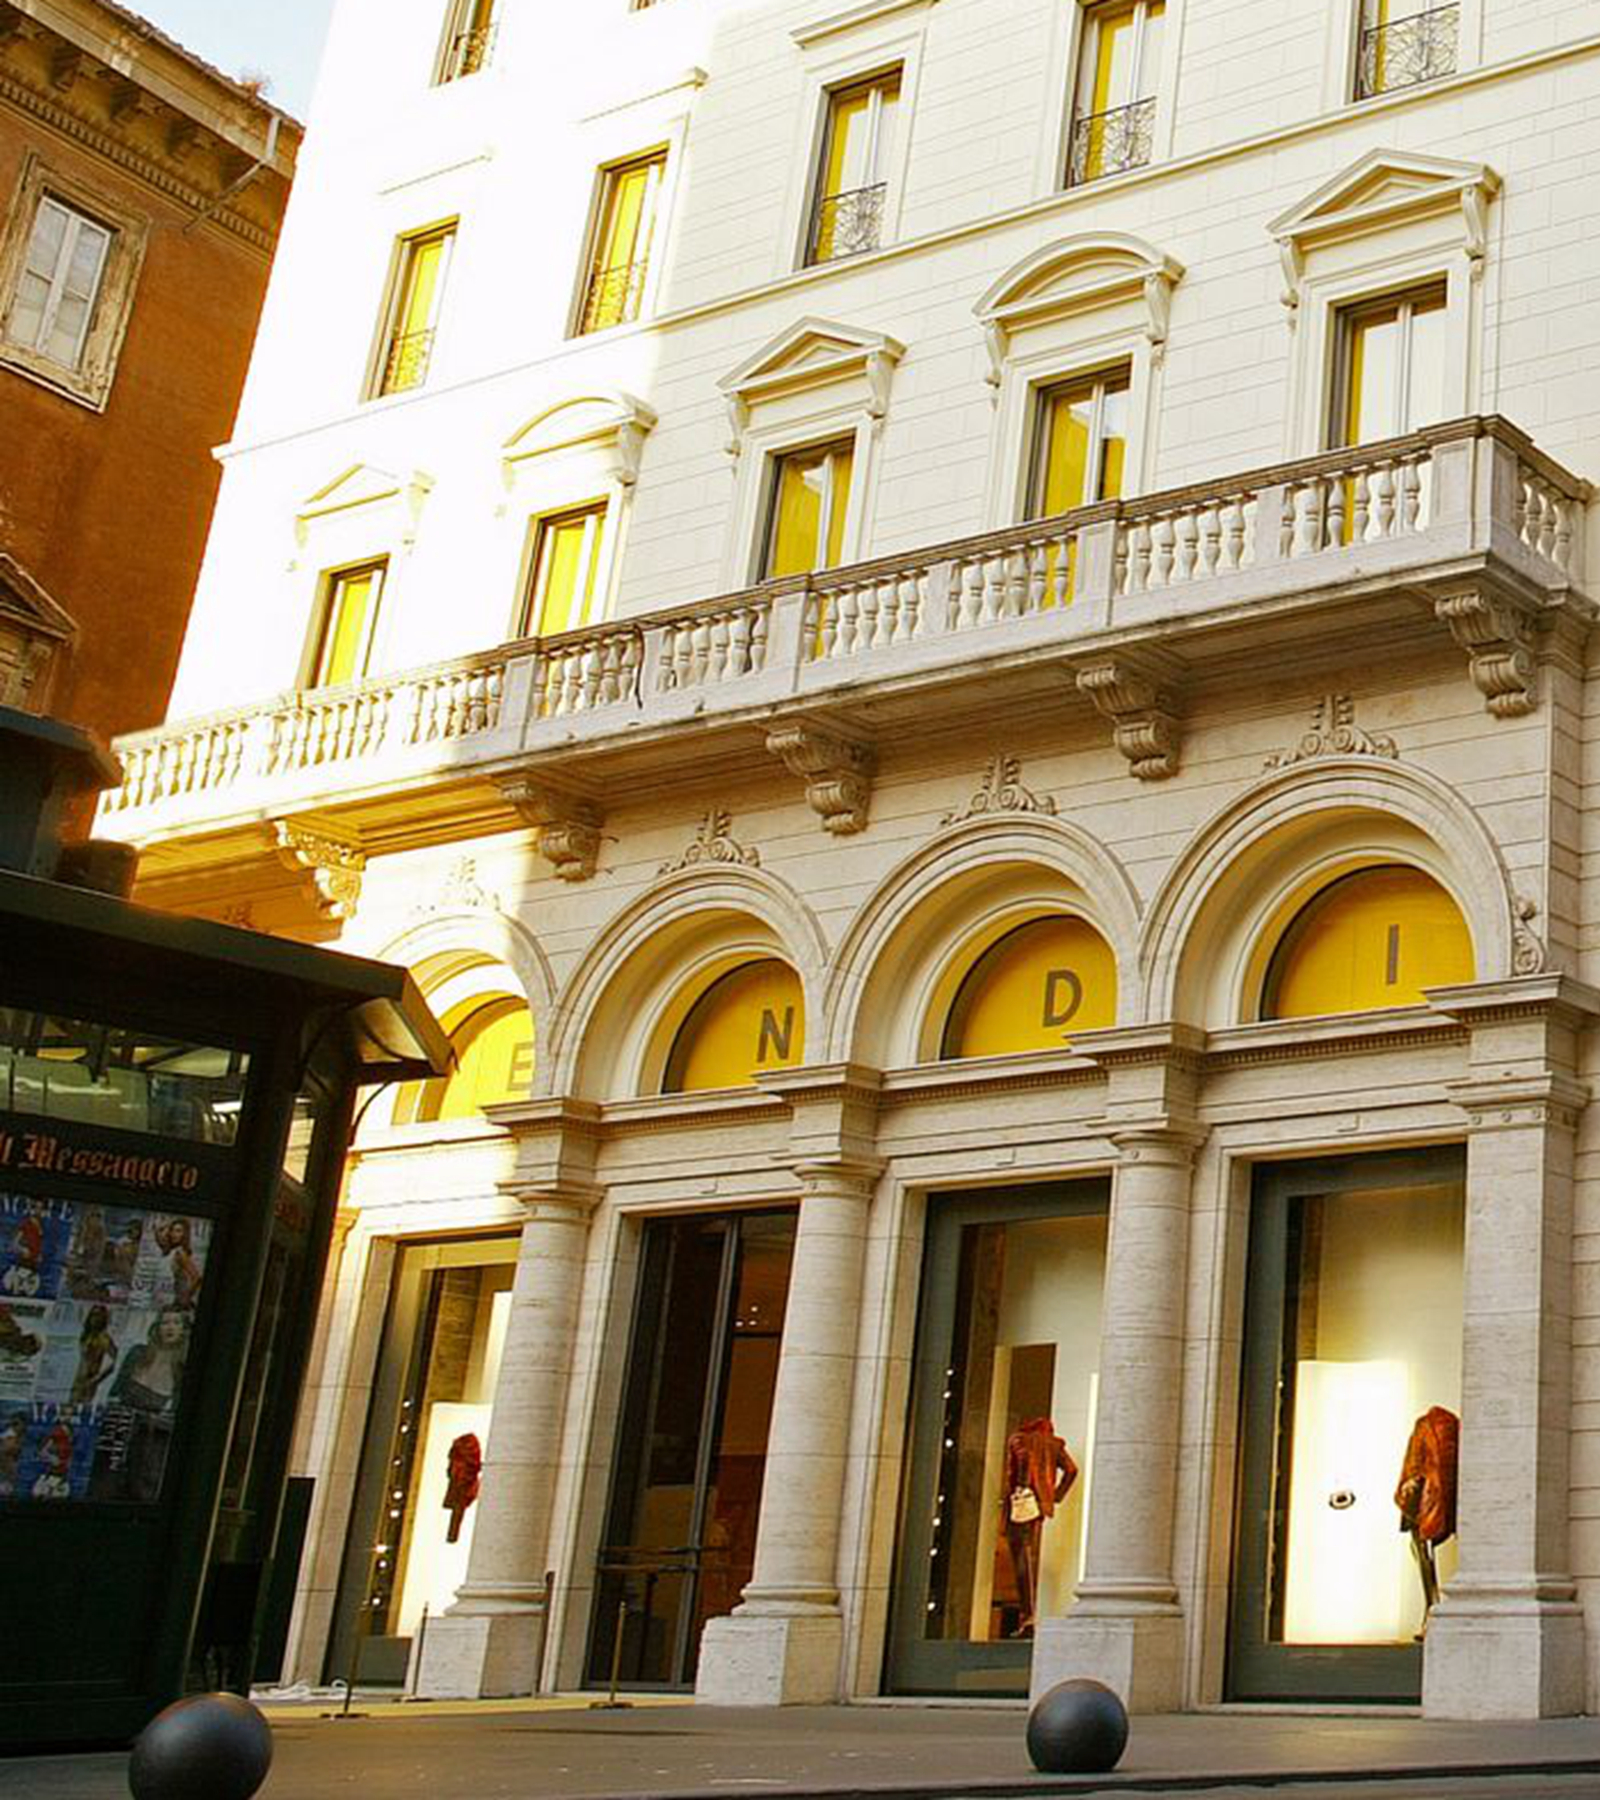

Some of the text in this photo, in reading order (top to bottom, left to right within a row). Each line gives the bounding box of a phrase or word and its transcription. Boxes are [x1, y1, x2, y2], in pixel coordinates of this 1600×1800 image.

[756, 1005, 795, 1062] N
[1042, 969, 1083, 1028] D
[1384, 923, 1400, 986] I
[18, 1132, 200, 1193] Messaggero
